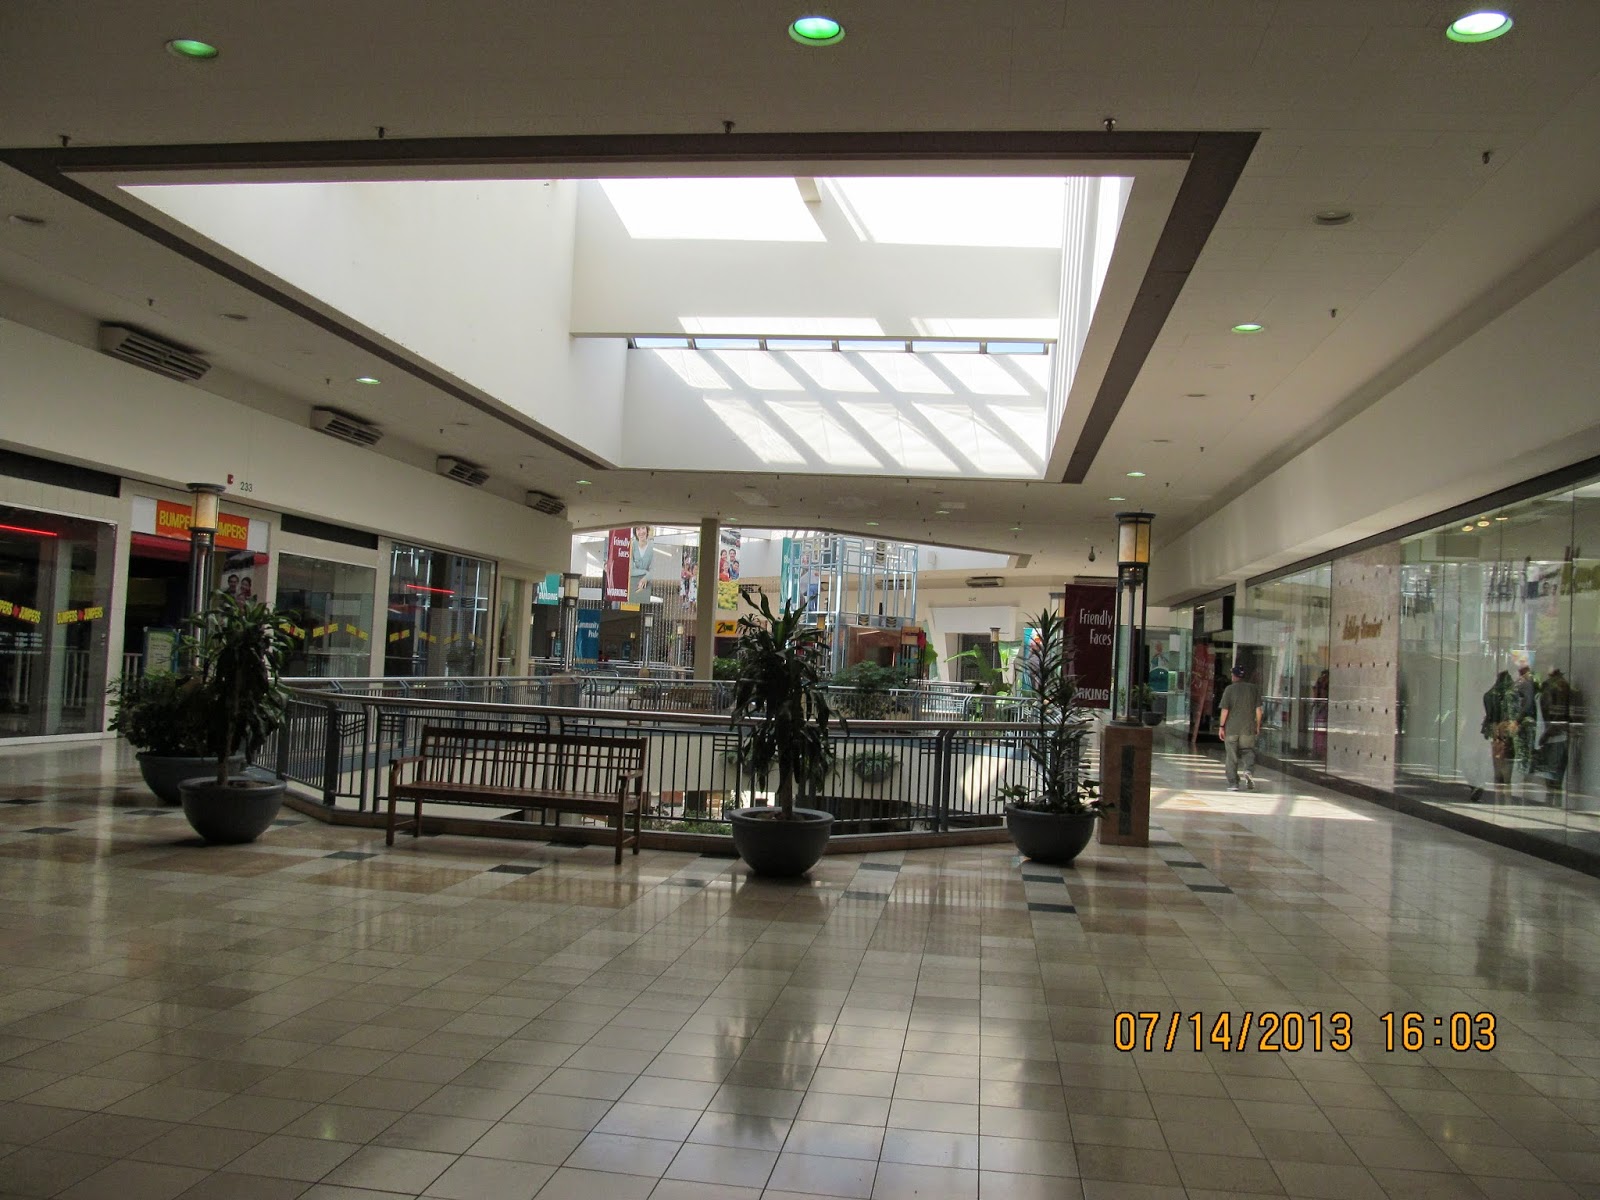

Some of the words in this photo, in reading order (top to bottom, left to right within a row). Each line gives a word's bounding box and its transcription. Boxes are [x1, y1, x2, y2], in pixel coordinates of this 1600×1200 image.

[240, 481, 253, 493] 233
[159, 510, 192, 531] BUMPE
[613, 536, 630, 549] Friendly
[606, 587, 628, 598] WORKING
[1079, 608, 1113, 629] Friendly
[1089, 628, 1112, 646] Faces
[1074, 687, 1109, 701] RKING
